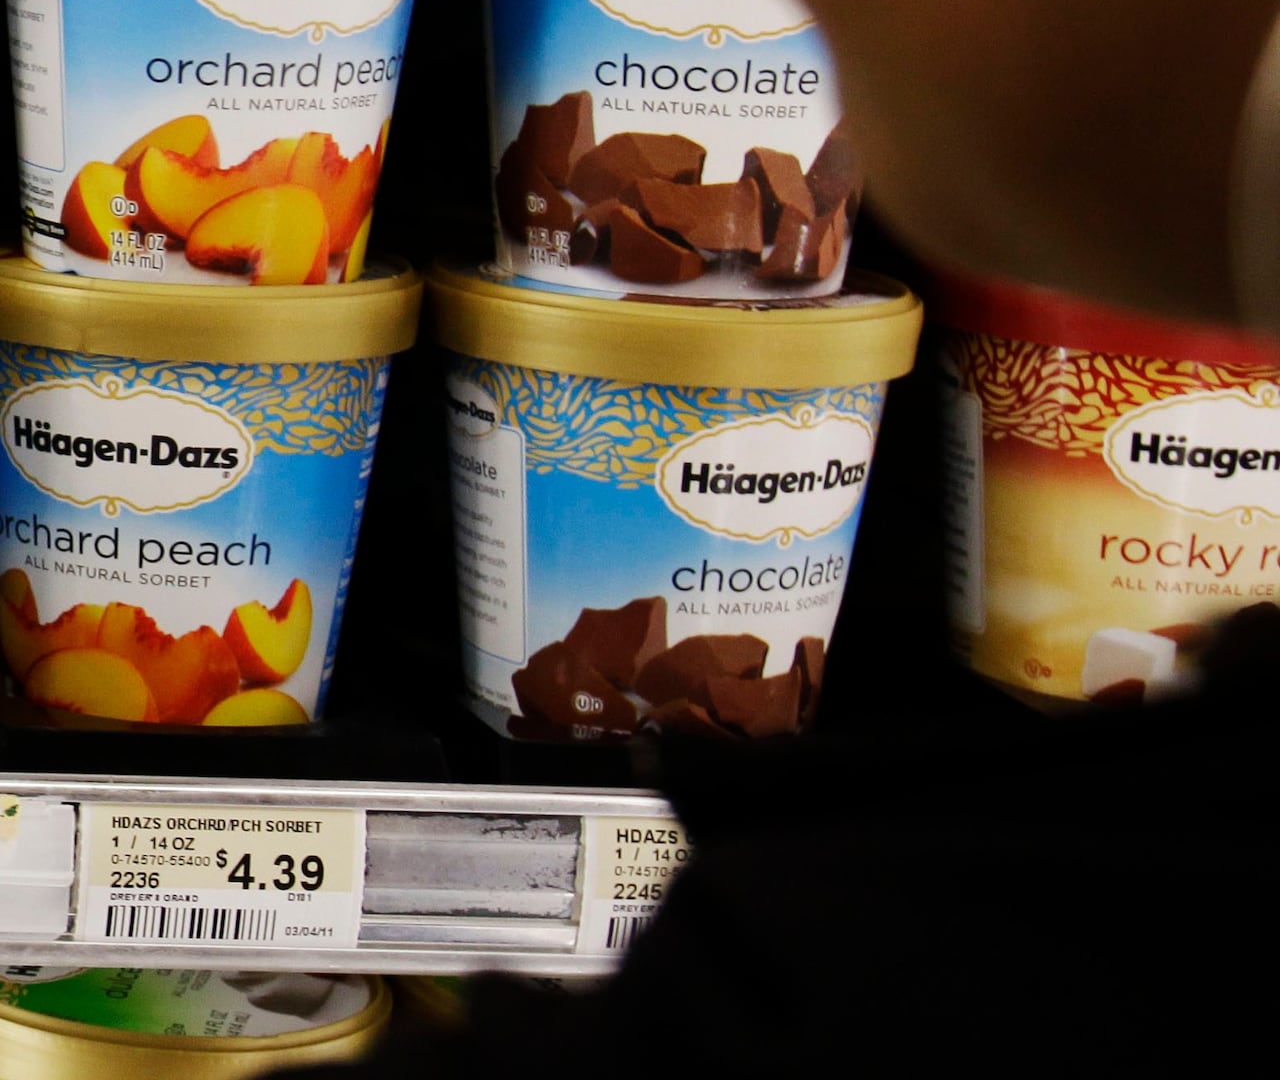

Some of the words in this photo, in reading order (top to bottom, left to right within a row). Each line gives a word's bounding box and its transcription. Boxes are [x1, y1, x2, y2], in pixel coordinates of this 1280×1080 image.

[146, 53, 322, 88] orchard
[595, 53, 819, 95] chocolate
[207, 96, 240, 111] ALL
[248, 96, 326, 112] NATURAL
[331, 94, 377, 109] SORBET
[602, 98, 636, 112] ALL
[642, 100, 732, 117] NATURAL
[739, 104, 808, 119] SORBET
[110, 232, 123, 248] 14
[128, 234, 142, 249] FL
[146, 234, 165, 251] OZ
[110, 250, 137, 268] (414
[140, 253, 164, 272] mL)
[138, 533, 272, 569] peach
[1100, 532, 1243, 578] rocky
[24, 555, 49, 572] ALL
[54, 561, 132, 584] NATURAL
[139, 572, 211, 589] SORBET
[672, 554, 845, 593] chocolate
[111, 816, 162, 830] HDAZS
[166, 817, 262, 833] ORCHRD/PCH
[266, 820, 323, 834] SORBET
[110, 872, 160, 889] 2236
[215, 848, 325, 892] $4.39
